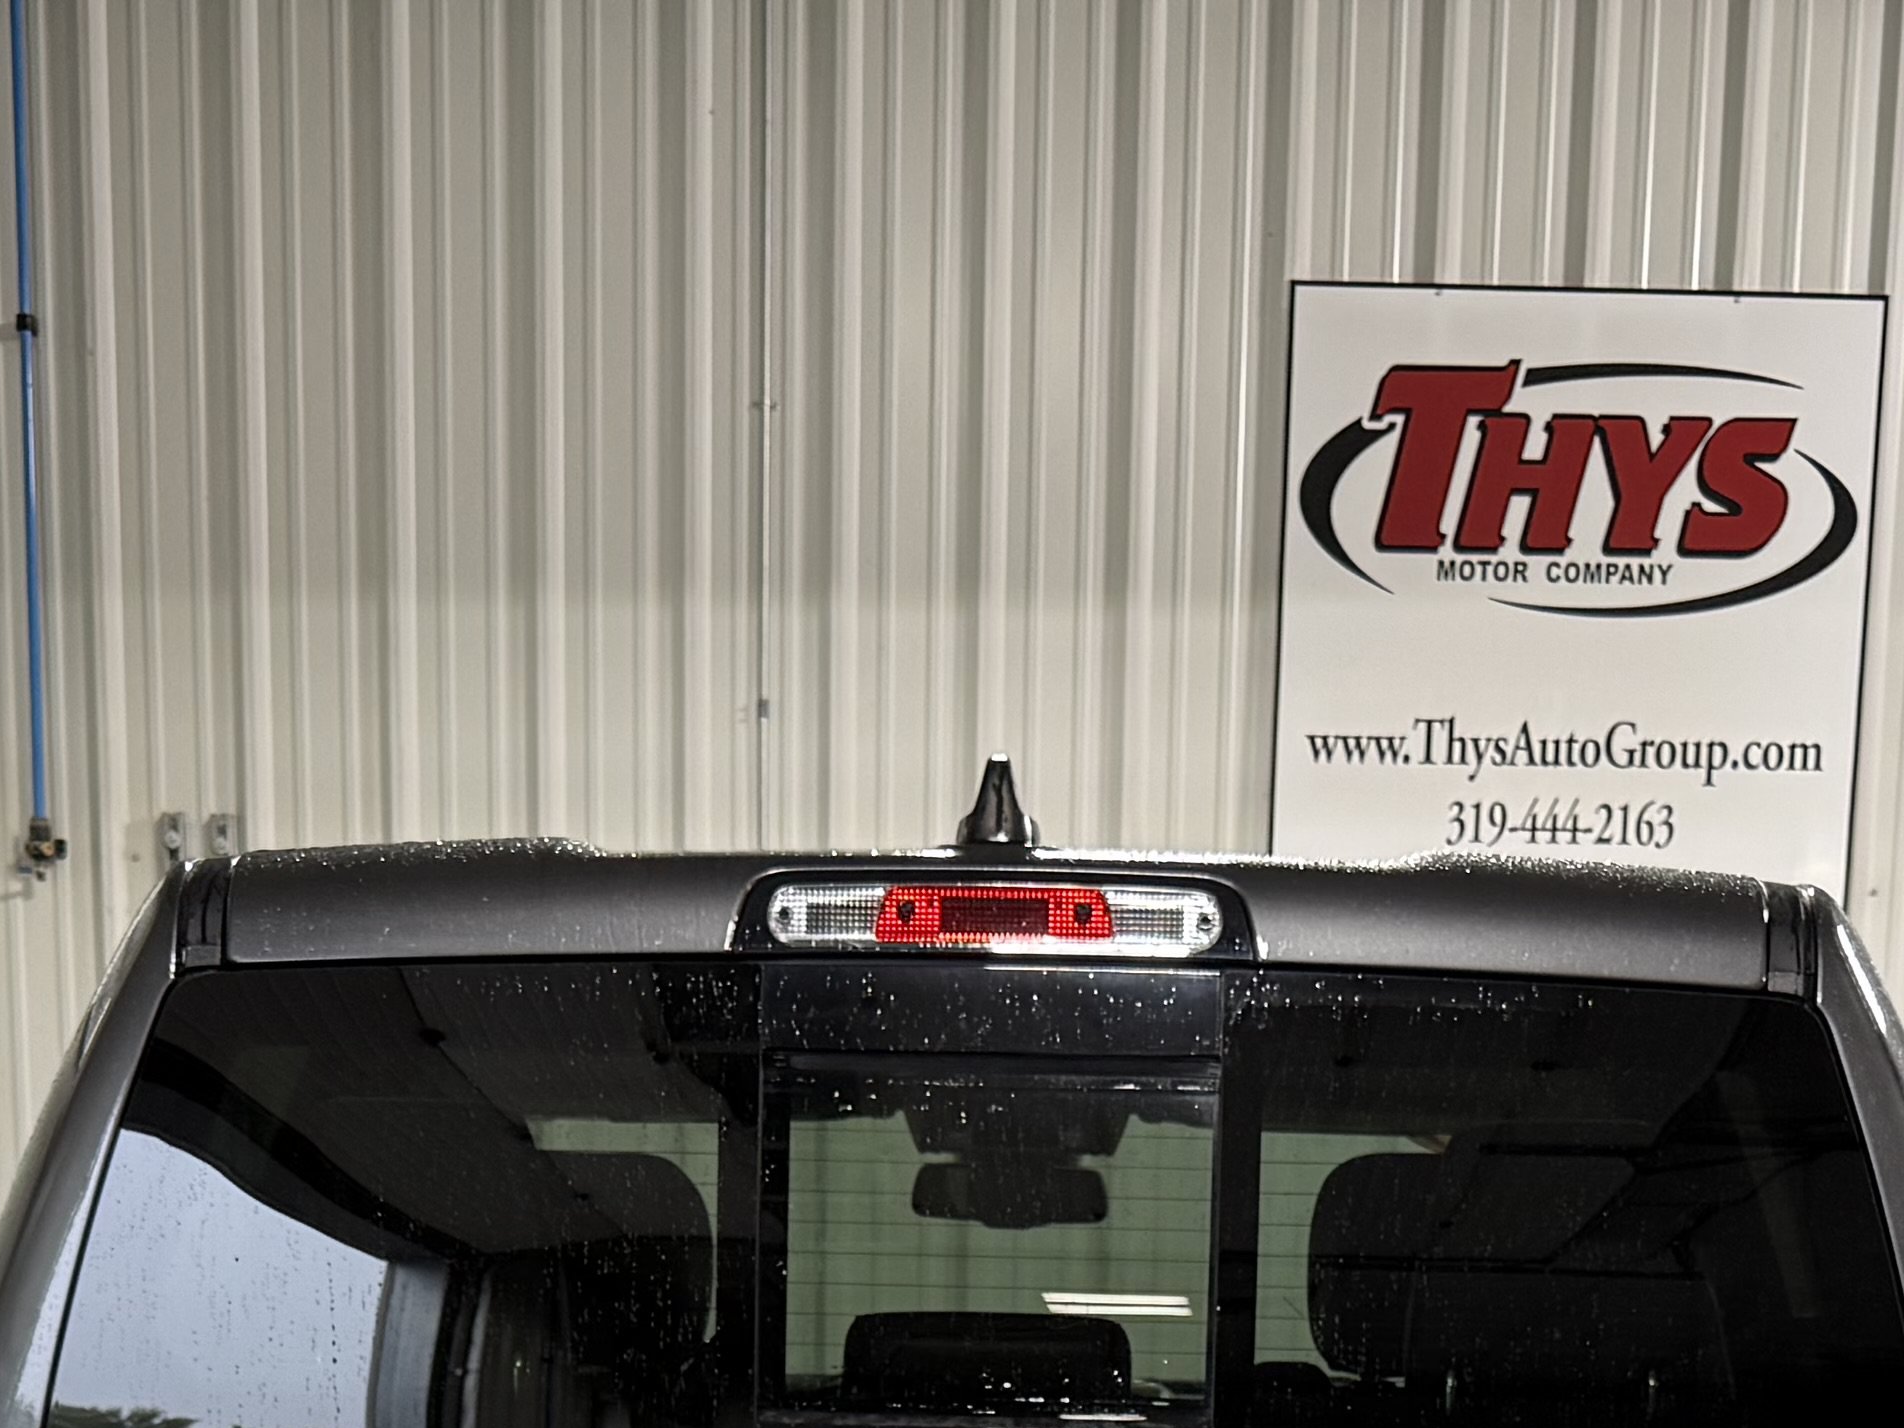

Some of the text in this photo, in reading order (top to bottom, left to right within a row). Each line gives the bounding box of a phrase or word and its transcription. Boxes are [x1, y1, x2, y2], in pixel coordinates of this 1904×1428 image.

[1369, 357, 1799, 557] THYS
[1435, 559, 1673, 587] MOTOR COMPANY
[1305, 716, 1825, 787] www.ThysAutoGroup.com
[1445, 797, 1676, 849] 319-444-2163
